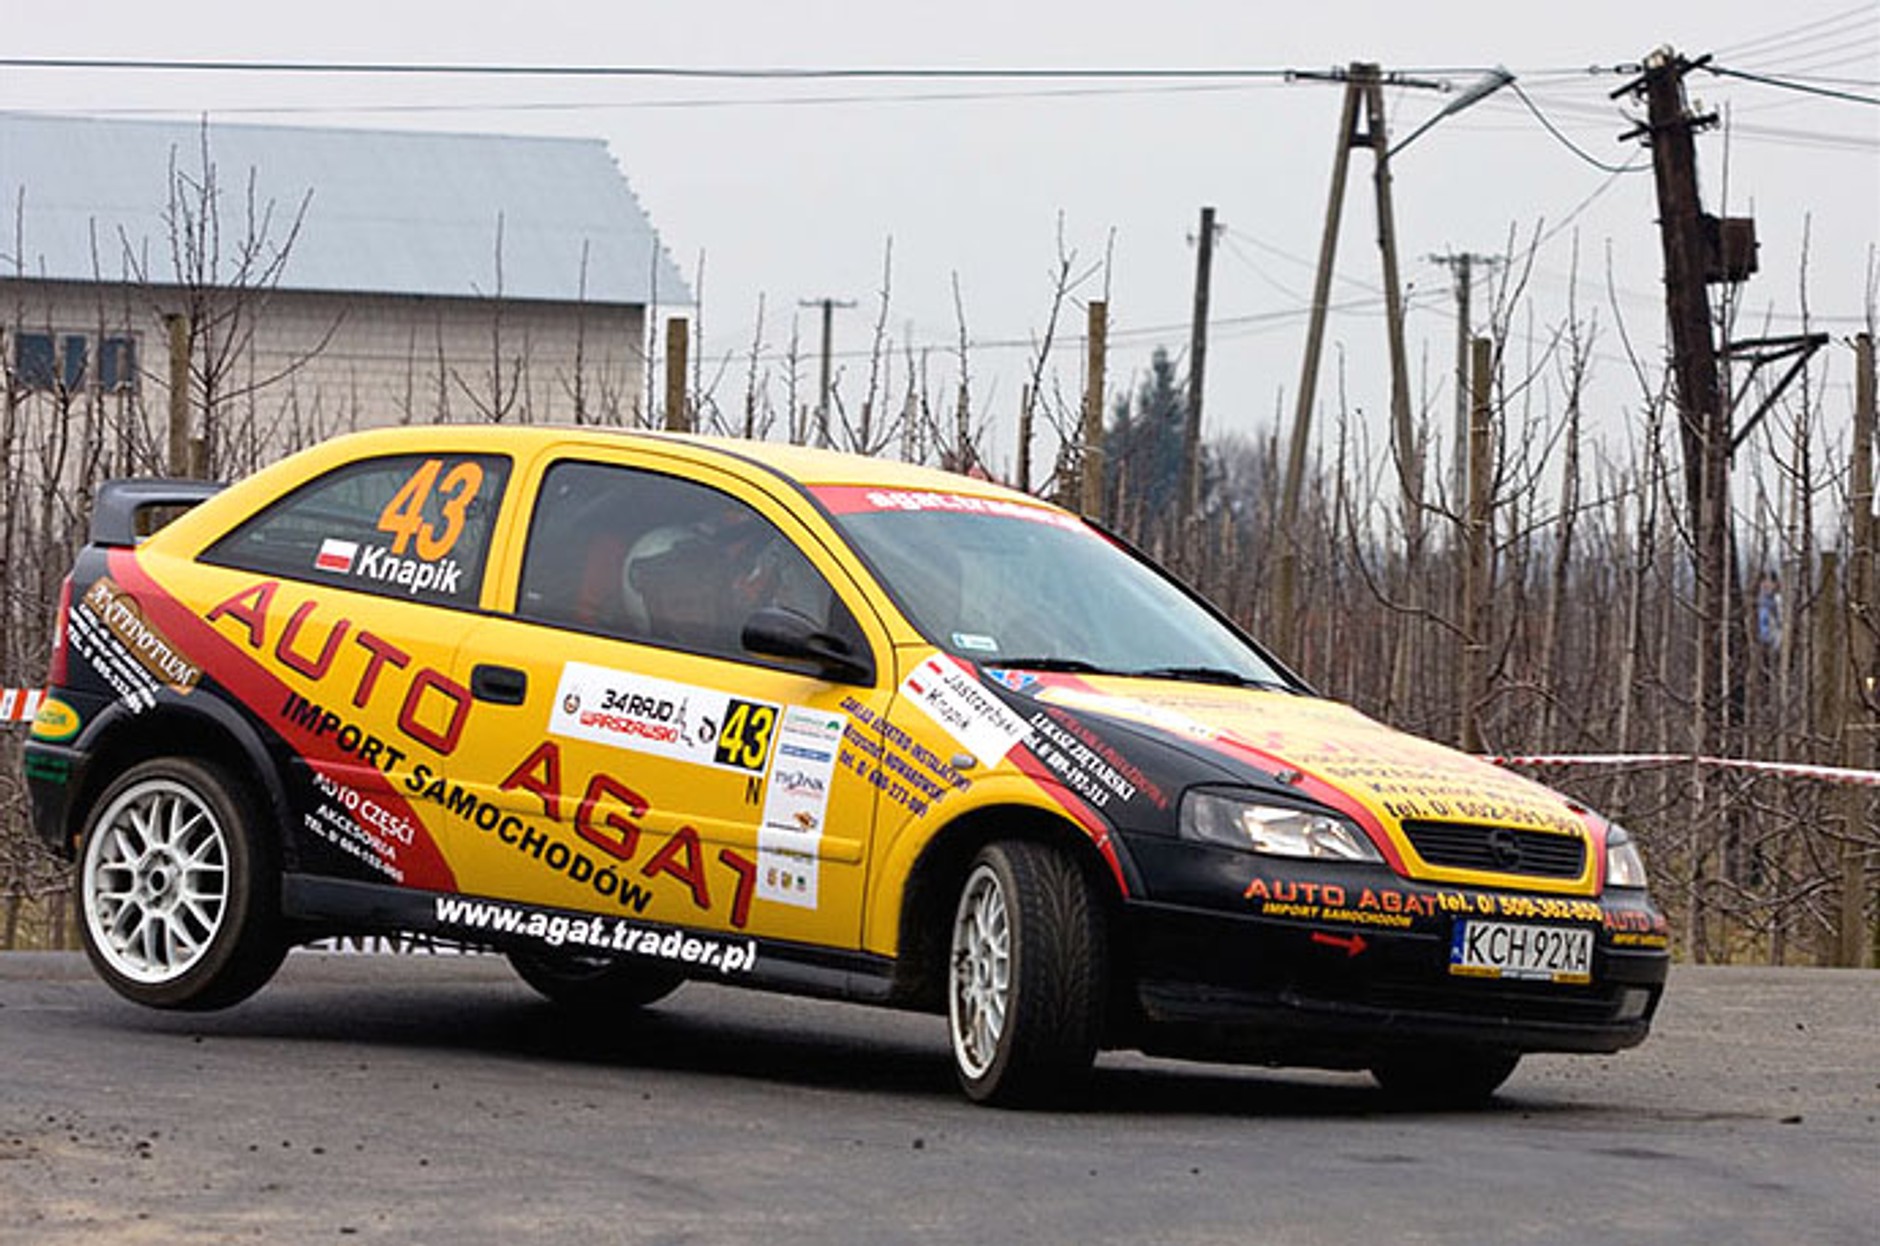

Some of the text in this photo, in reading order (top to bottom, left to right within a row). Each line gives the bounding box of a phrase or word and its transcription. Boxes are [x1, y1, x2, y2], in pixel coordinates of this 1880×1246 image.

[377, 459, 484, 562] 43
[356, 546, 462, 594] Knapik
[206, 581, 473, 757] AUTO
[498, 740, 757, 929] AGAT
[718, 703, 774, 769] 43
[281, 692, 654, 914] IMPORT SAMOCHODÓW
[313, 772, 360, 810] AUTO
[745, 776, 763, 805] N
[1243, 877, 1437, 917] AUTO AGAT
[1437, 890, 1474, 913] tel.
[436, 897, 756, 974] www.agat.trader.pl
[1466, 925, 1589, 971] KCH 92XA
